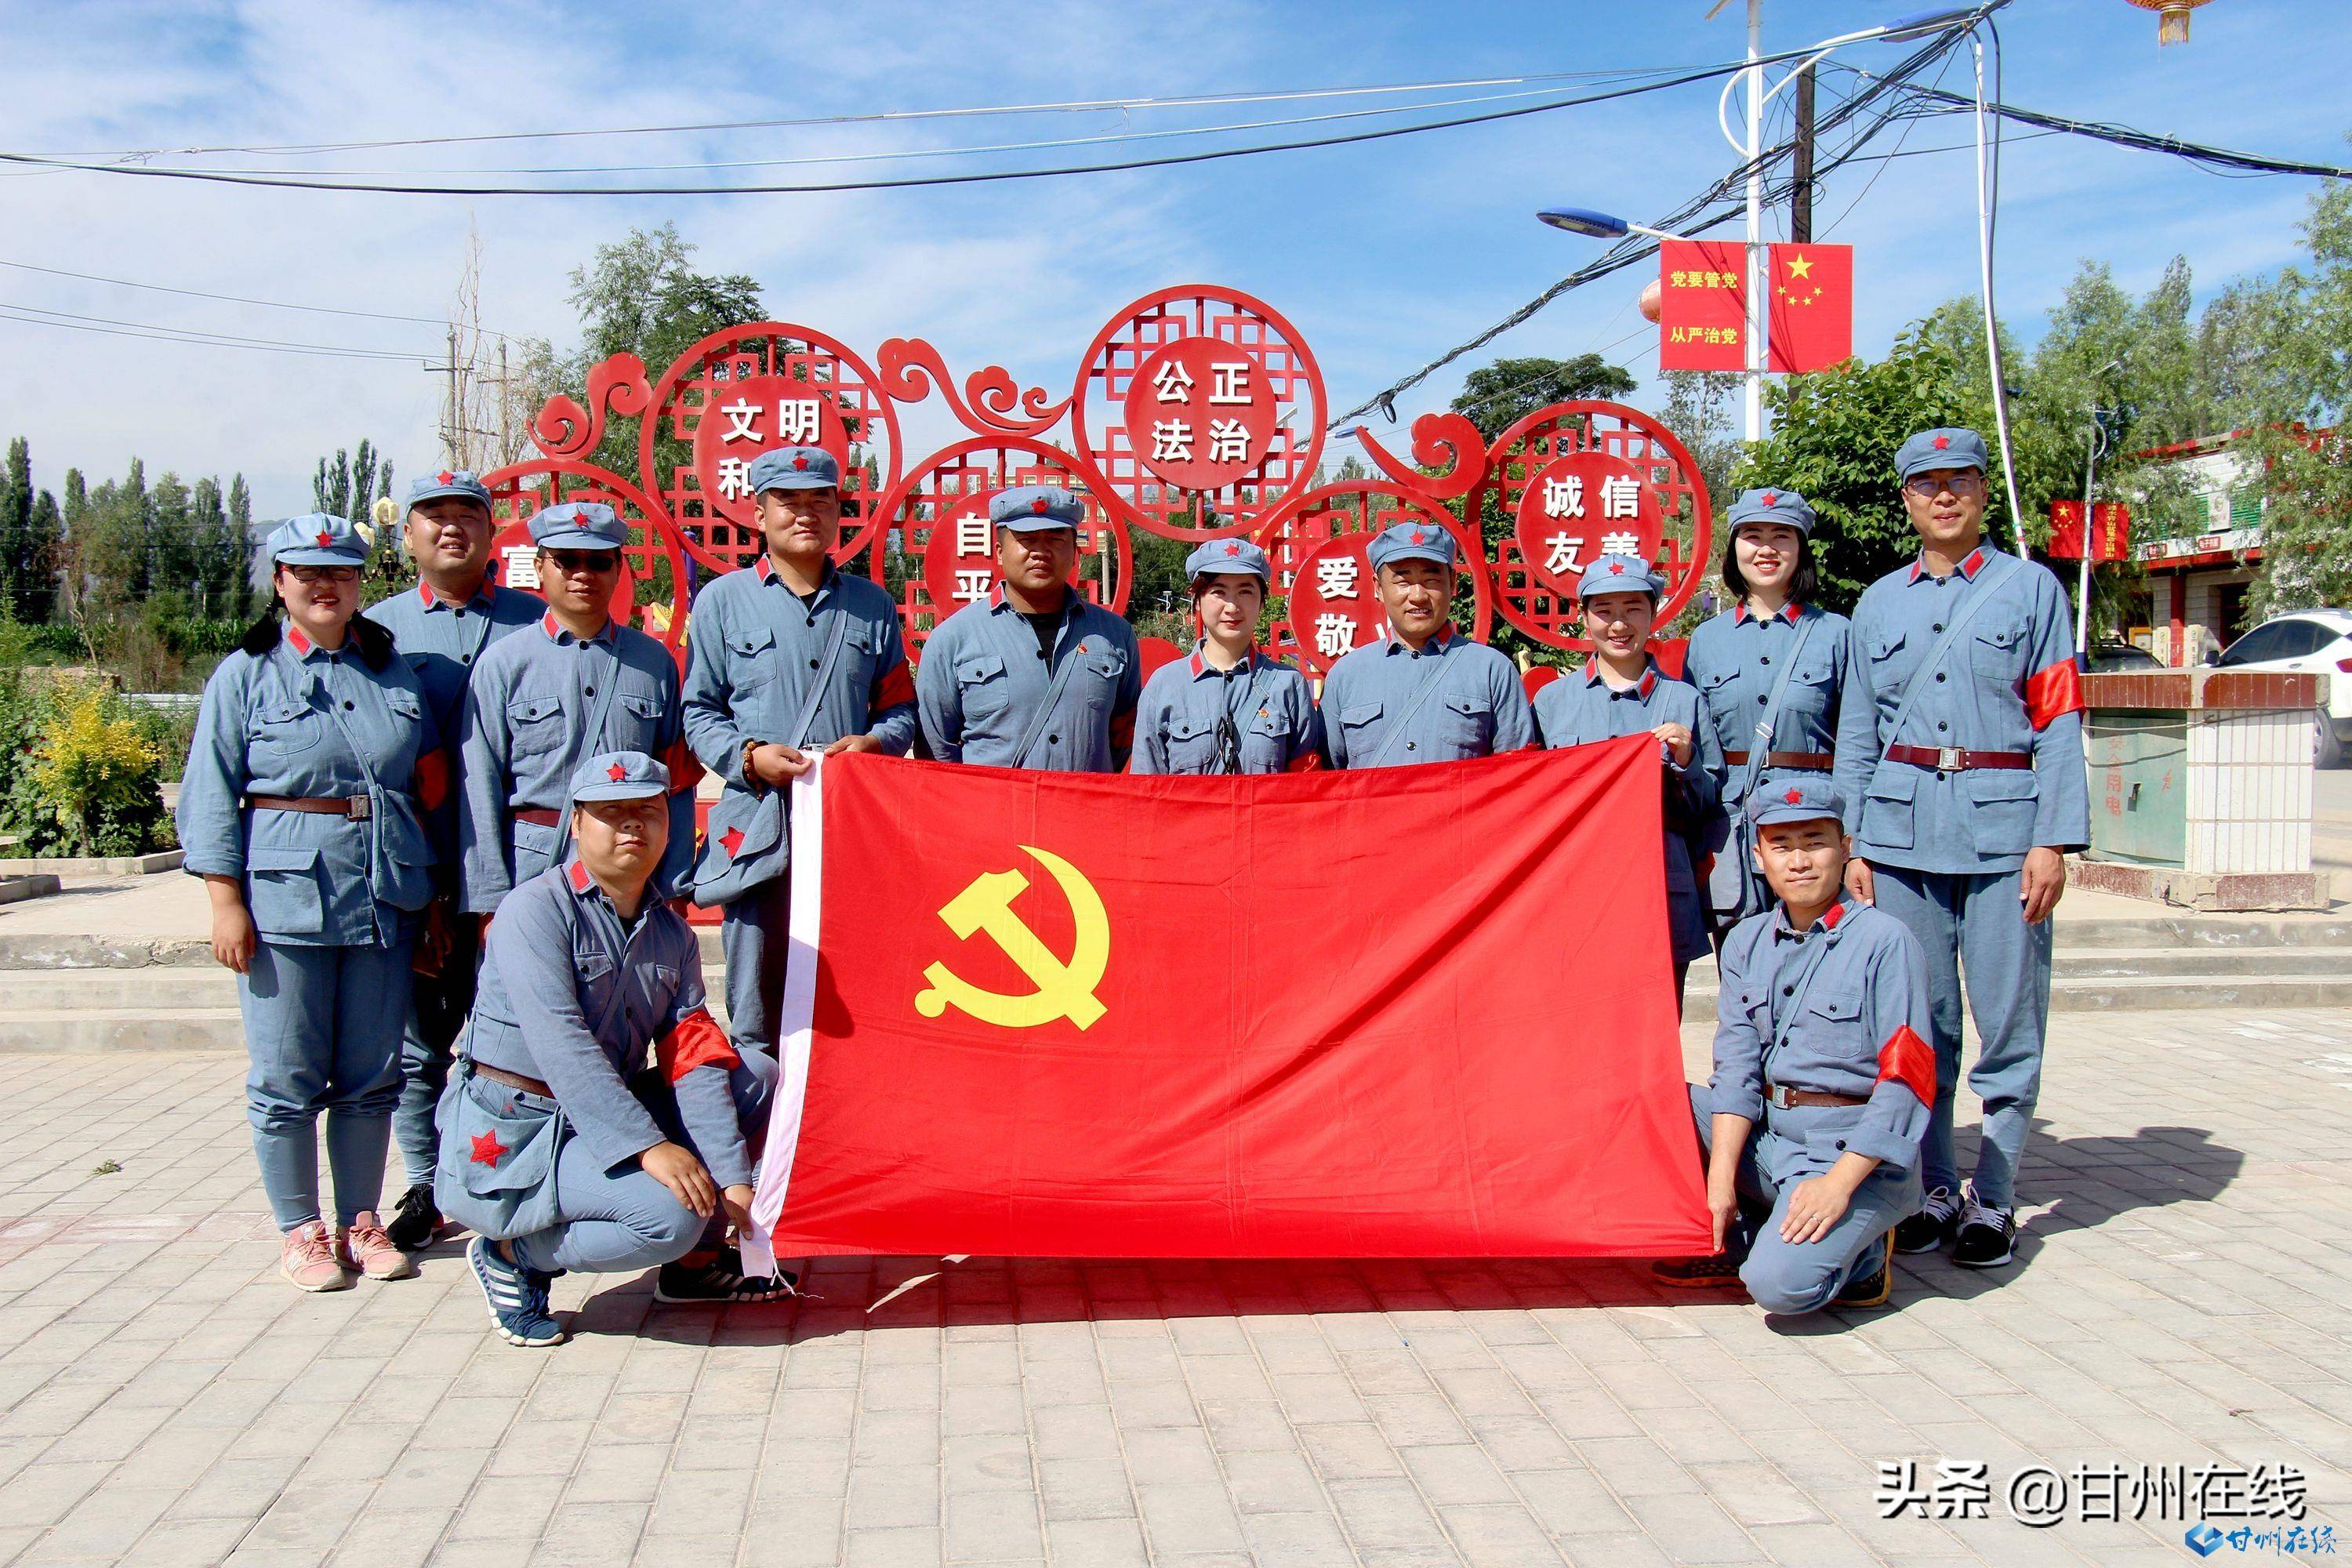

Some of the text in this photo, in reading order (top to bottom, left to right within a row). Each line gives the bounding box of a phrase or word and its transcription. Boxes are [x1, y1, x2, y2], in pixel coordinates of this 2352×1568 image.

[1670, 270, 1738, 289] 党要管党
[1670, 327, 1737, 345] 从严治党
[1152, 359, 1253, 405] 公正
[720, 397, 821, 445] 文明
[1151, 418, 1252, 464] 法治
[1542, 474, 1642, 518] 诚信
[956, 512, 992, 557] 自
[1544, 531, 1641, 575] 友善
[501, 544, 541, 590] 富
